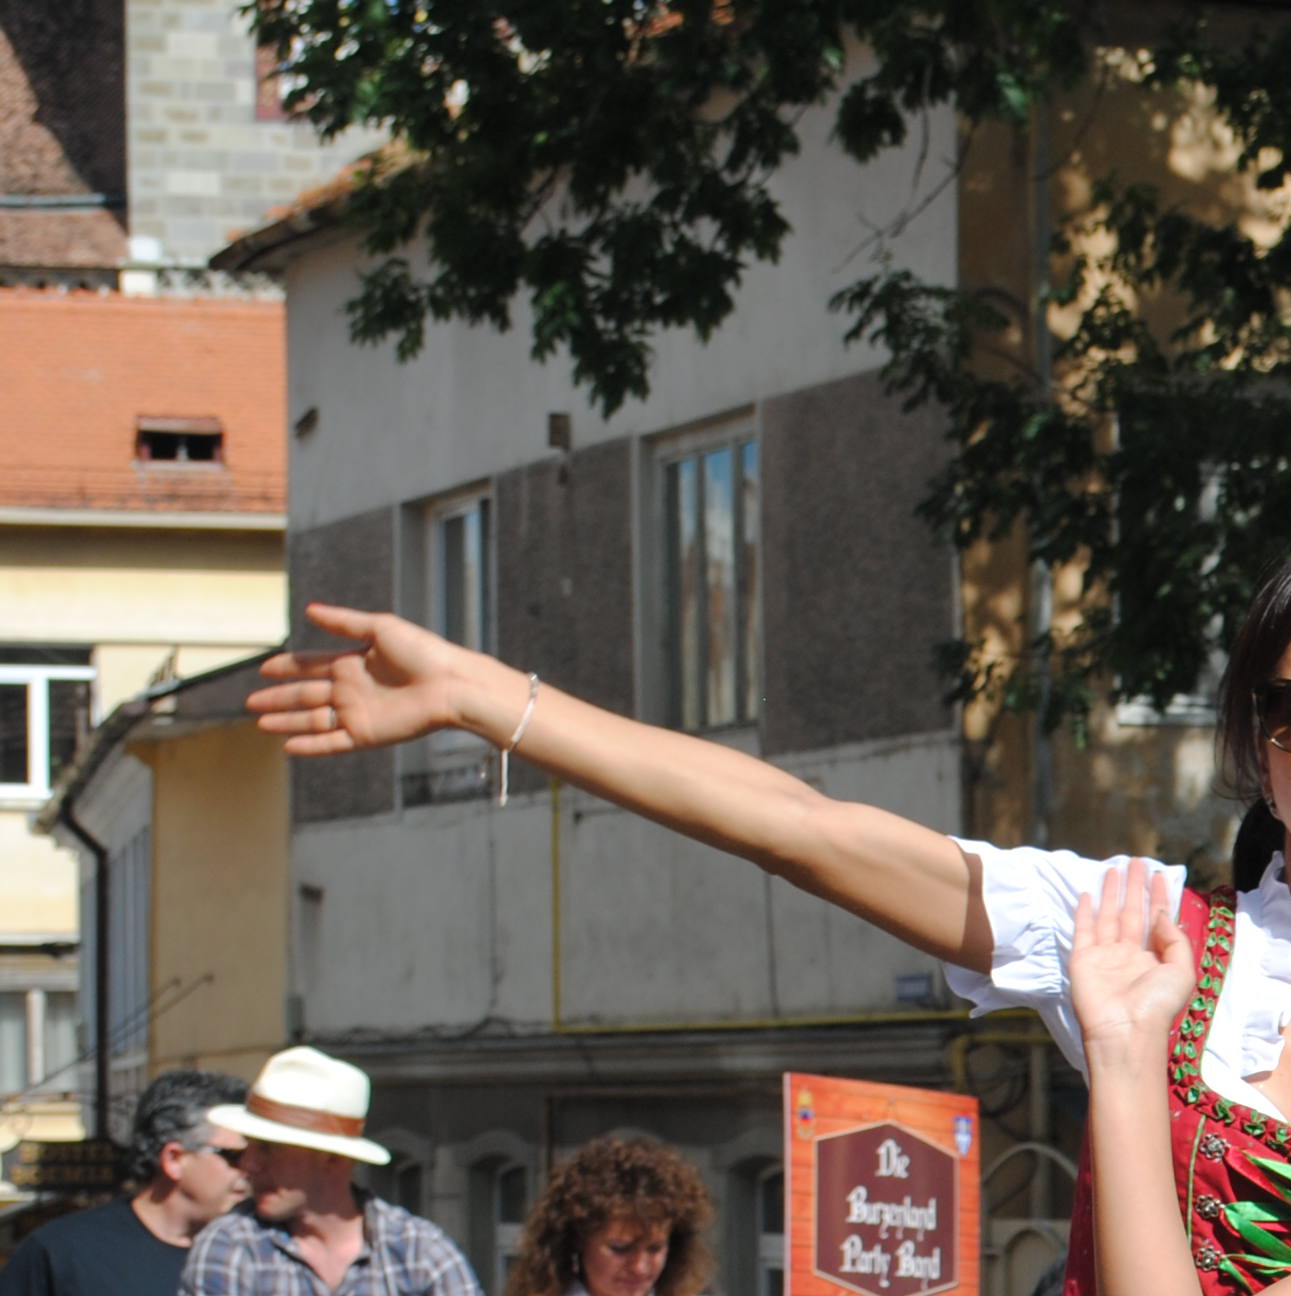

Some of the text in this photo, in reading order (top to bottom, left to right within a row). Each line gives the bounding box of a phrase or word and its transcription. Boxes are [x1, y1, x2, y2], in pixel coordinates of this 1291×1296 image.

[875, 1138, 910, 1178] Die
[839, 1233, 941, 1291] Party Band
